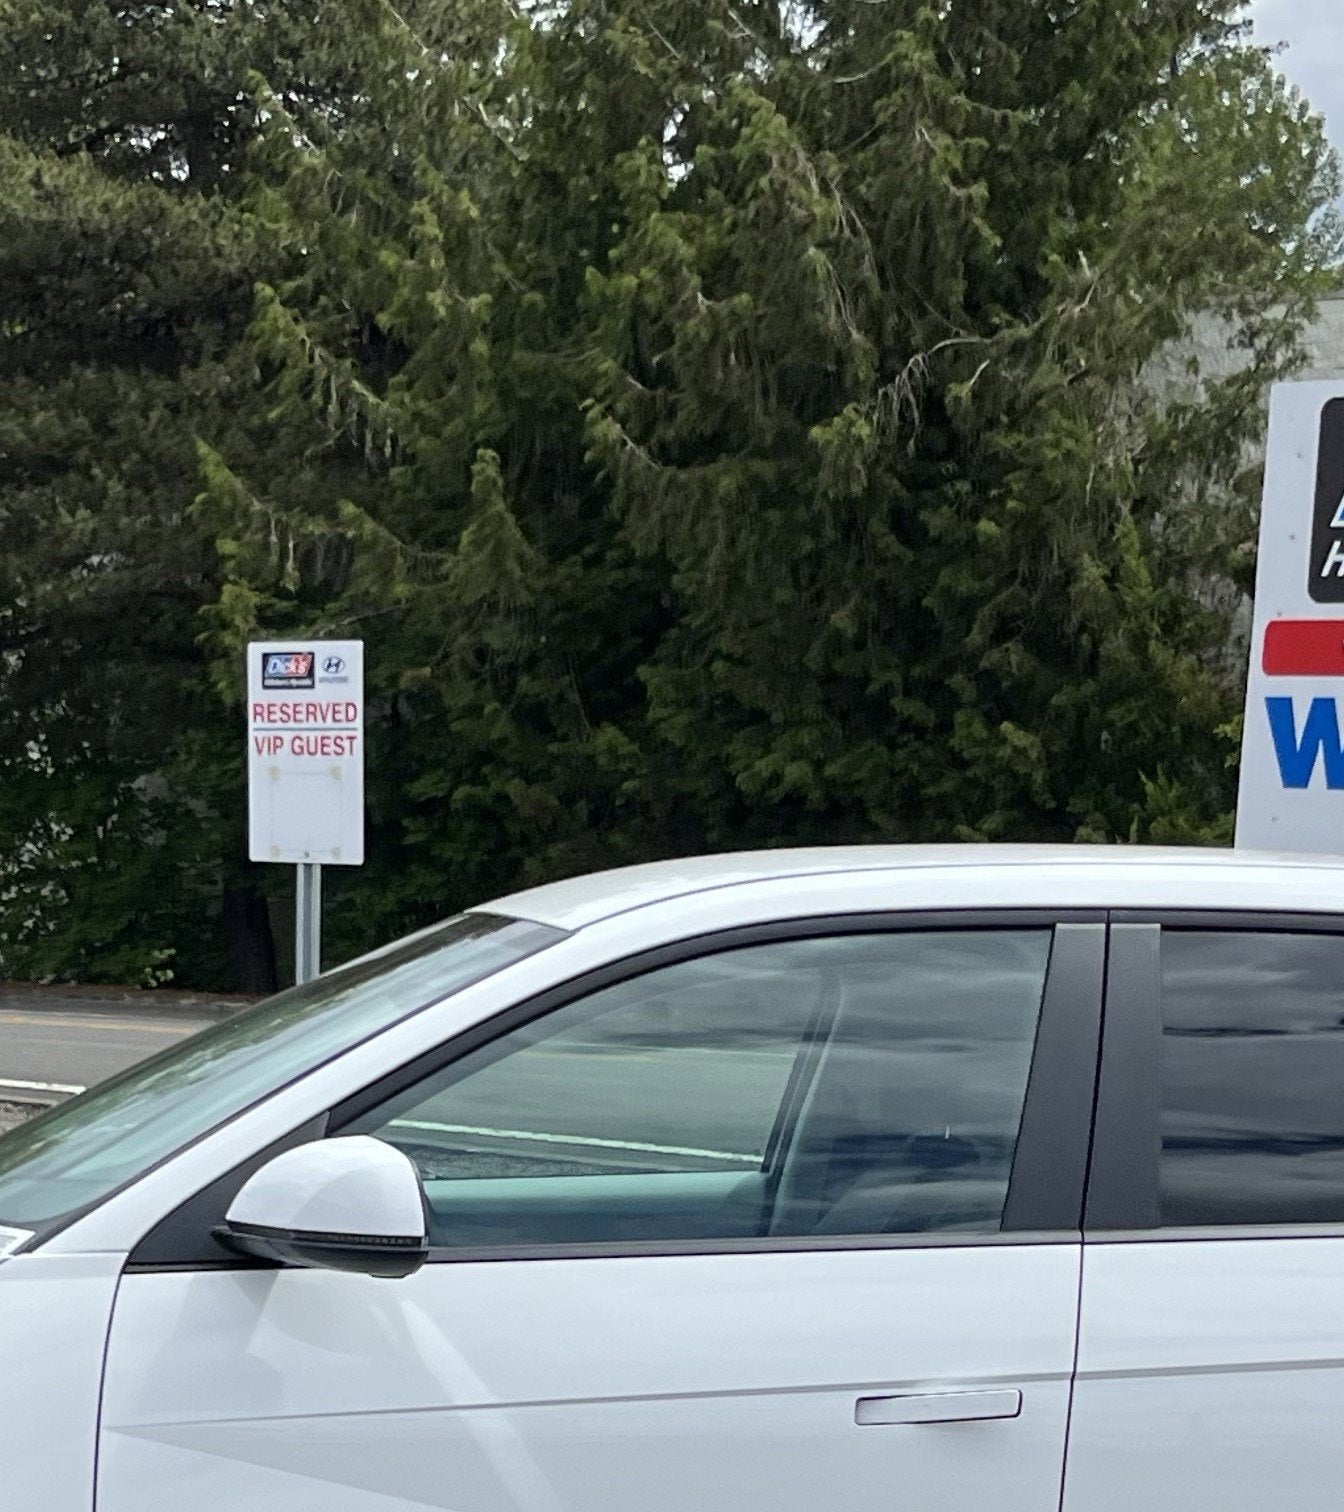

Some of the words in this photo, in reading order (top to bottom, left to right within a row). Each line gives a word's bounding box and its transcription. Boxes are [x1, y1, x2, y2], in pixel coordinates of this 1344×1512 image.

[252, 702, 358, 724] RESERVED
[254, 735, 284, 756] VIP
[291, 735, 358, 757] GUEST
